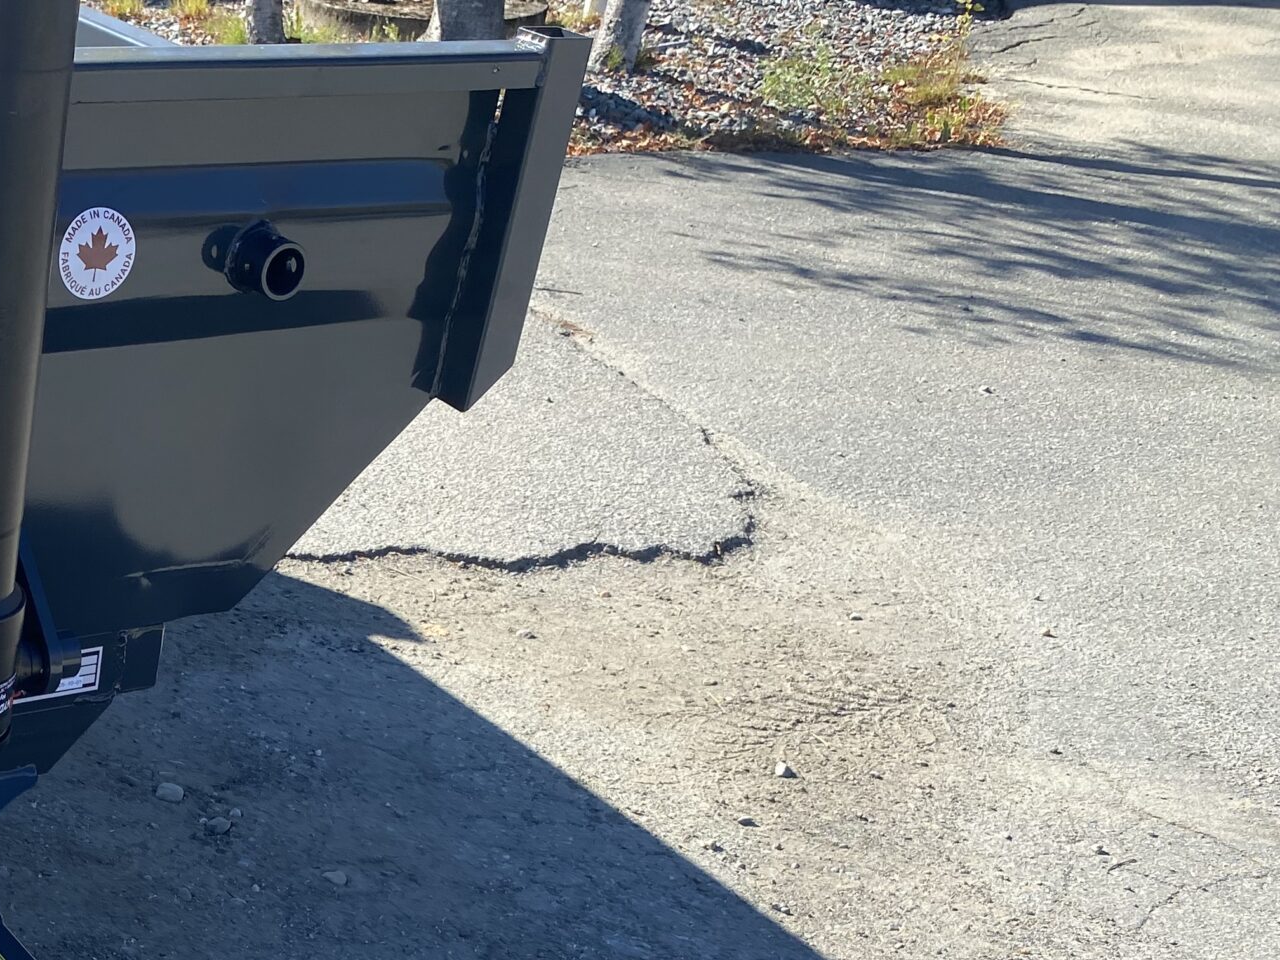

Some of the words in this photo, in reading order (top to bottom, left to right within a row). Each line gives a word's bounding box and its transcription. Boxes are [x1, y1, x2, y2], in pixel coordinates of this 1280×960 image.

[65, 214, 88, 243] MADE
[89, 209, 100, 220] IN
[103, 210, 133, 244] CANADA
[61, 251, 87, 296] FABRIQUÉ
[88, 287, 101, 297] AU
[104, 252, 133, 293] CANADA
